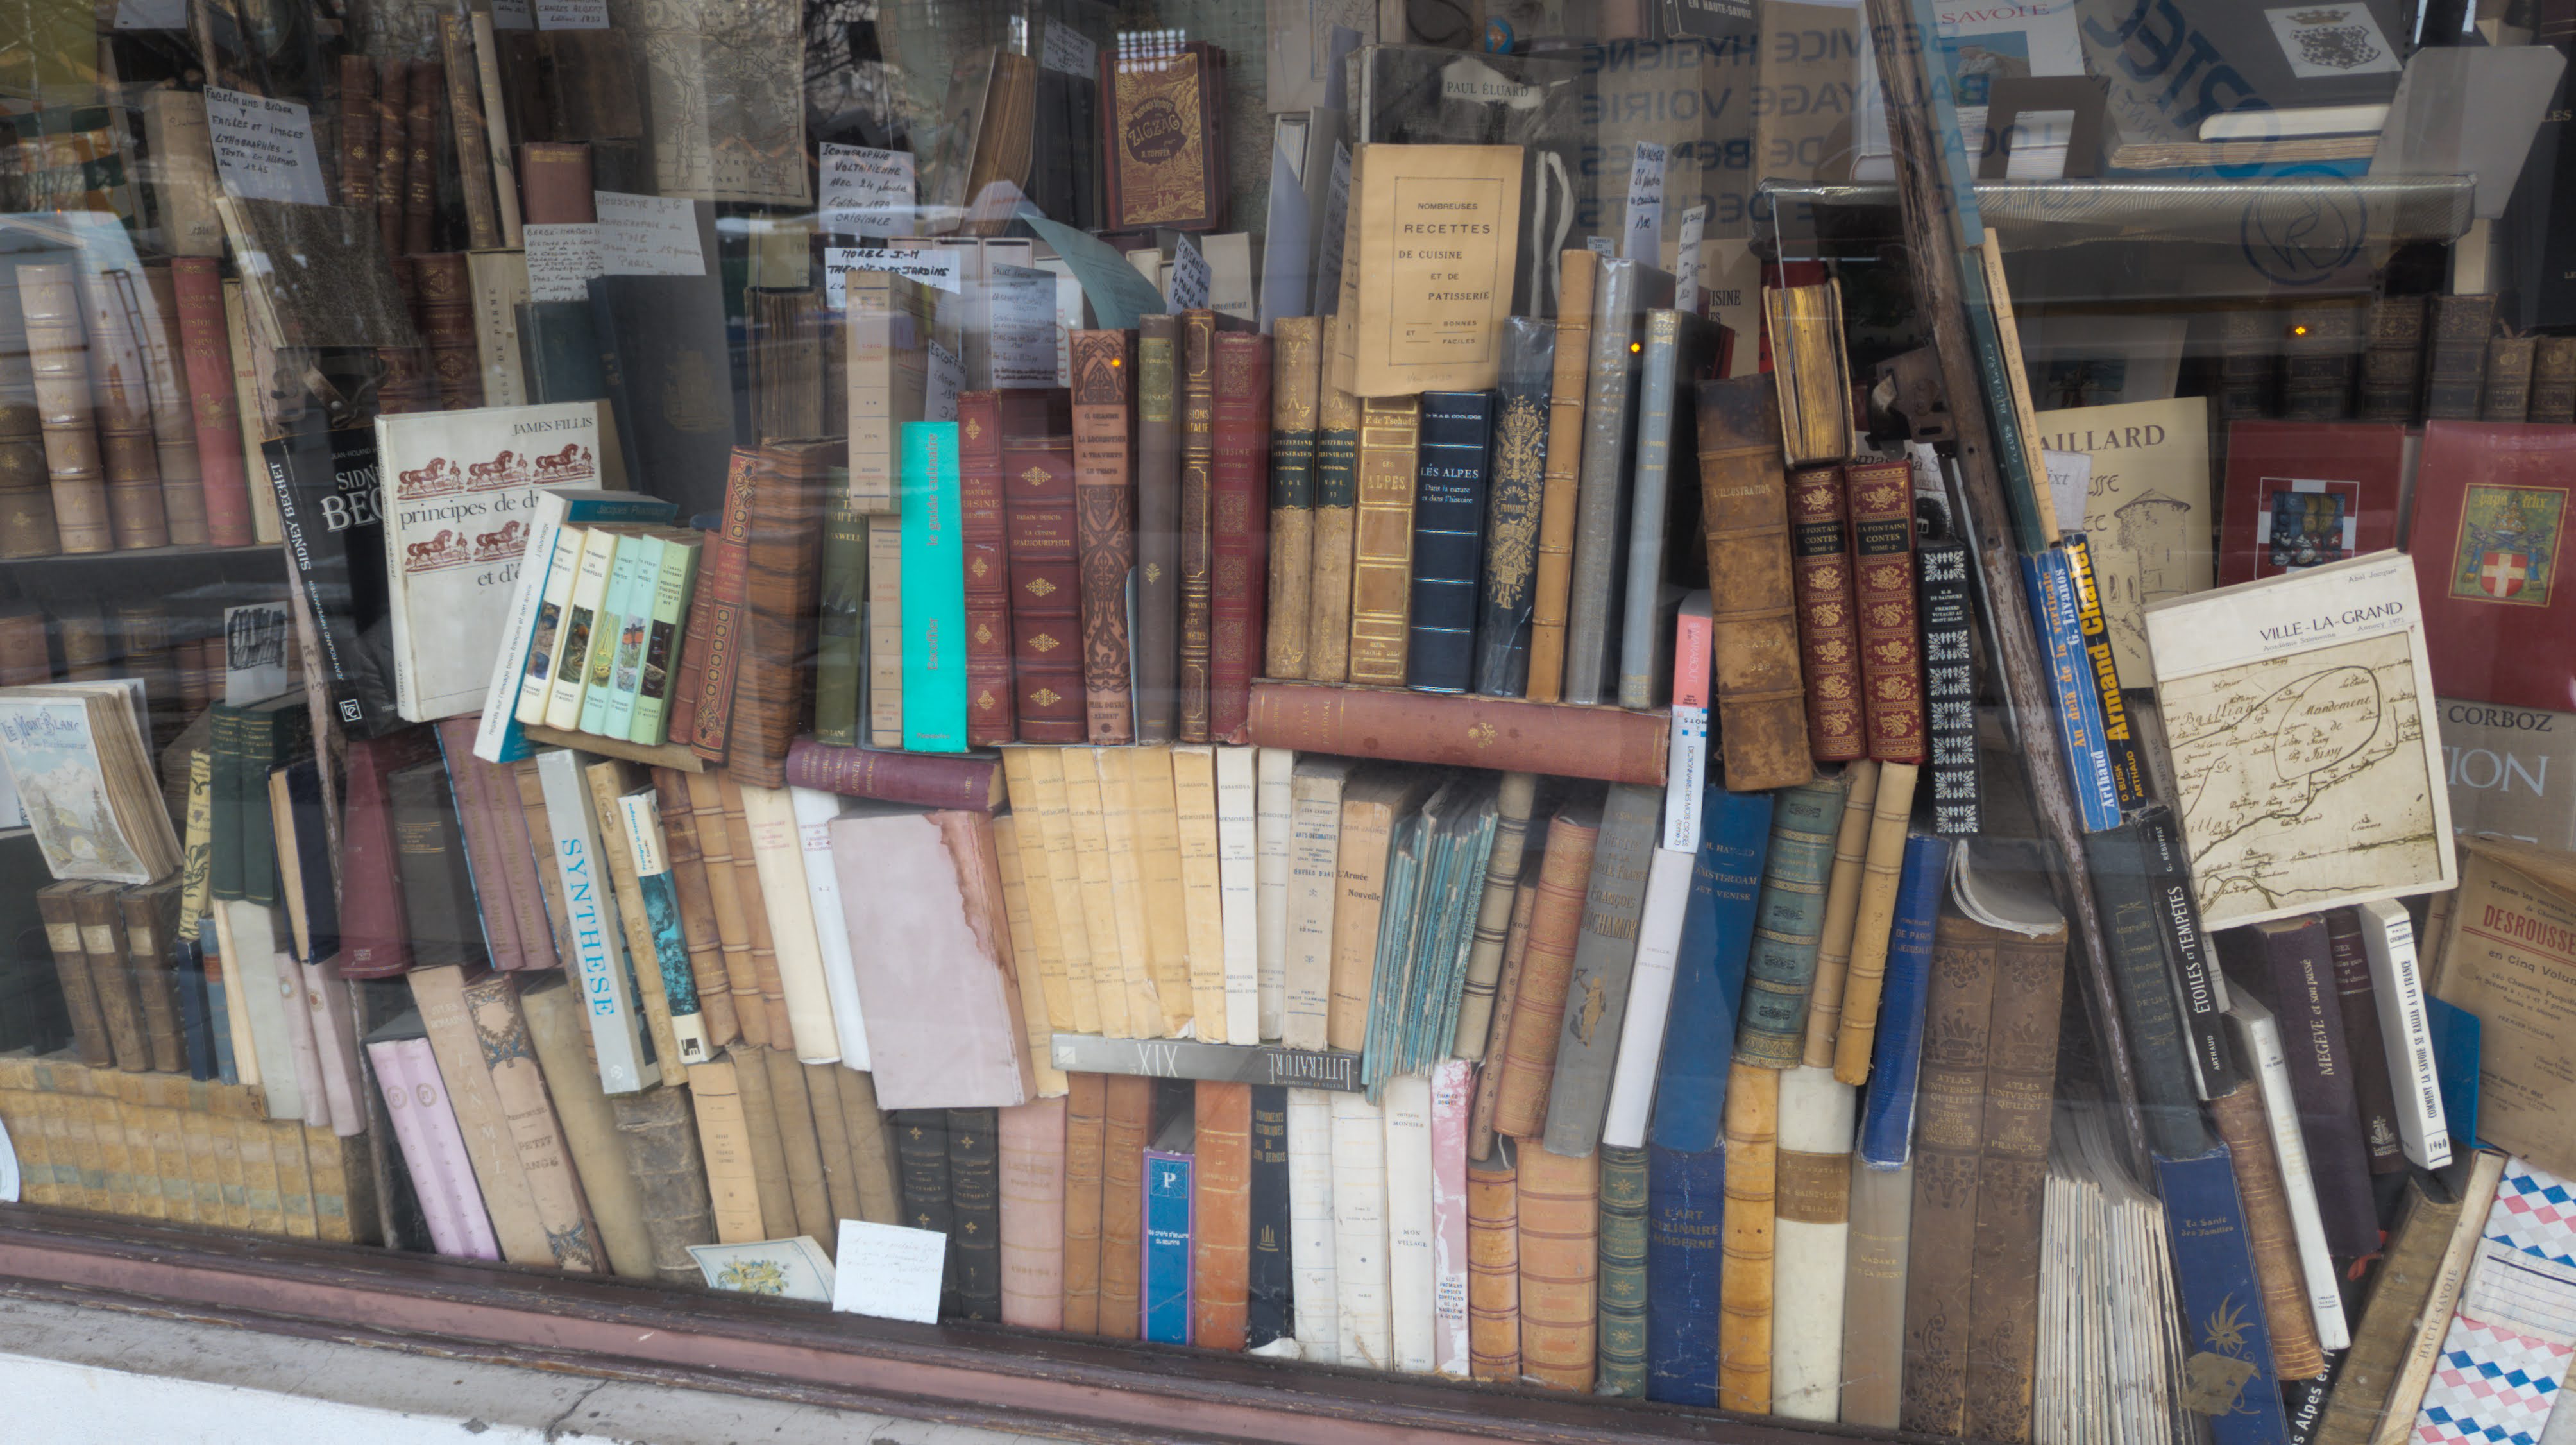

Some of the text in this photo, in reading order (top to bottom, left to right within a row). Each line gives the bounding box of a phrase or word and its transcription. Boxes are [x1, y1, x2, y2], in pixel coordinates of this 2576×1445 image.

[1703, 1, 1752, 19] HAUTE-SAVOIE
[1941, 5, 2050, 25] SAVOIE
[1446, 81, 1529, 98] PAUL ÉLUARD
[1417, 201, 1479, 210] NOMBREUSES
[1403, 223, 1492, 235] RECETTES
[1398, 249, 1462, 260] DE CUISINE
[1447, 272, 1460, 280] DE
[1428, 291, 1490, 301] PATISSERIE
[511, 416, 594, 437] JAMES FILLIS
[1443, 468, 1479, 480] ALPES
[926, 433, 942, 547] le guide culinaire
[1425, 484, 1441, 492] Dans
[269, 461, 312, 572] SIDNEY BECHET
[400, 500, 487, 530] principes
[495, 493, 517, 513] de
[1867, 522, 1908, 533] FONTAINE
[1804, 534, 1838, 544] CONTES
[1865, 533, 1901, 543] CONTES
[477, 572, 496, 588] et
[2348, 571, 2367, 583] Abel
[2042, 570, 2062, 634] verticale
[2055, 569, 2080, 645] G. Livanos
[926, 615, 940, 672] Escoffier
[2067, 542, 2130, 741] Armand Charlet
[2056, 643, 2067, 658] la
[2060, 665, 2074, 683] de
[2447, 704, 2554, 733] CORBOZ
[2073, 726, 2086, 748] Au
[2090, 750, 2115, 808] Arthaud
[2116, 764, 2126, 791] BUSK
[2126, 750, 2144, 798] ARTHAUD
[2155, 825, 2174, 873] G. RÉBUFFAT
[1337, 869, 1369, 882] L'Armée
[1695, 864, 1758, 886] AMSTERDAM
[1347, 887, 1382, 902] Nouvelle
[1715, 889, 1750, 902] VENISE
[2489, 880, 2520, 895] Toutes
[562, 838, 615, 1016] SYNTHESE
[2168, 885, 2213, 1014] ÉTOILES ET TEMPÊTES
[2488, 948, 2537, 975] en Cinq
[2298, 959, 2319, 987] passé
[2403, 959, 2415, 984] FRANCE
[2307, 984, 2321, 1004] son
[2407, 985, 2416, 997] LA
[2310, 1003, 2322, 1016] et
[2411, 1005, 2424, 1032] RALLIA
[2416, 1031, 2425, 1043] SE
[2207, 1034, 2221, 1071] ARTHAUD
[2419, 1043, 2430, 1069] SAVOIE
[1267, 1051, 1351, 1091] LITTÉRATURE
[1936, 1073, 1973, 1085] ATLAS
[2422, 1070, 2431, 1081] LA
[1990, 1088, 2050, 1100] UNIVERSEL
[2004, 1081, 2041, 1091] ATLAS
[1930, 1093, 1975, 1104] QUILLET
[1997, 1099, 2043, 1111] QUILLET
[2427, 1082, 2437, 1119] COMMENT
[1393, 1120, 1424, 1129] MONNIER
[518, 1135, 554, 1152] PETIT
[1991, 1140, 2043, 1153] FRANÇAIS
[2428, 1137, 2448, 1153] 1960
[1163, 1170, 1177, 1189] P
[1665, 1208, 1704, 1220] L'ART
[1403, 1228, 1421, 1236] MON
[1397, 1239, 1428, 1248] VILLAGE
[2295, 1386, 2322, 1432] Alpes
